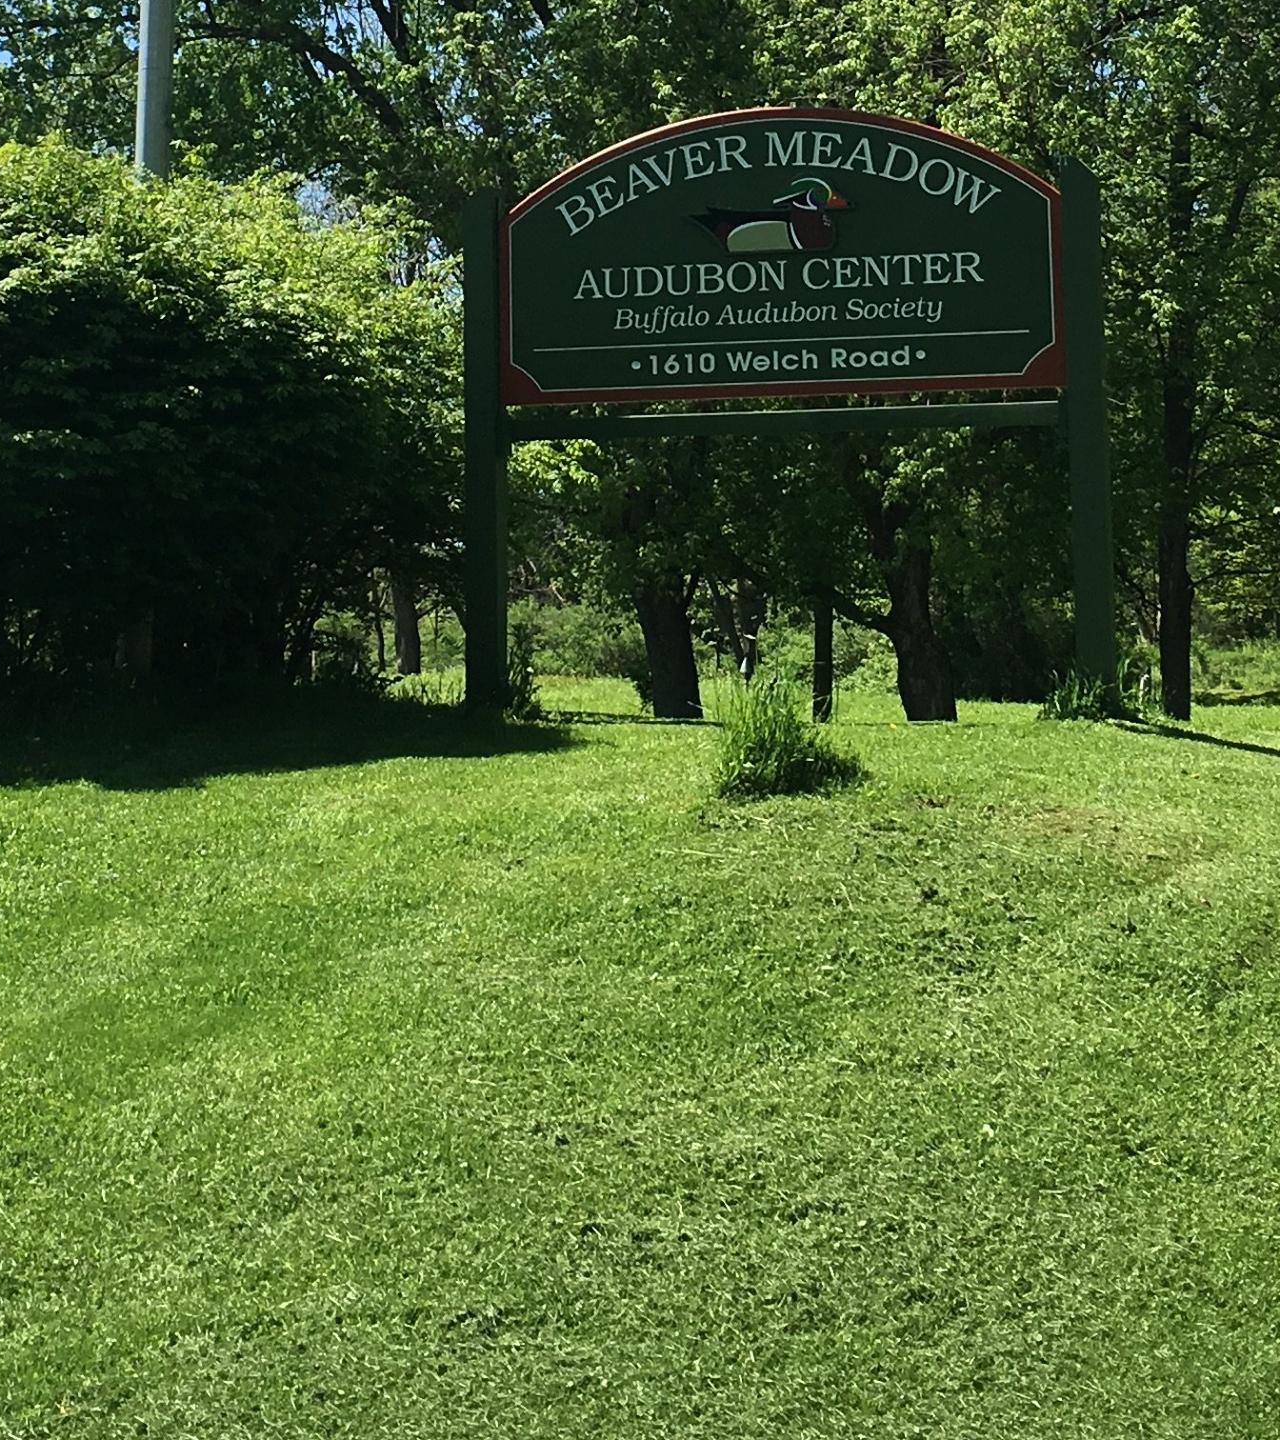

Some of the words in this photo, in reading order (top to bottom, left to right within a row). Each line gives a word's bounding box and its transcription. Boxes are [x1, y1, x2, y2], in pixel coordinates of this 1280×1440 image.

[554, 134, 753, 238] BEAVER
[763, 131, 1003, 216] MEADOW
[573, 260, 787, 300] AUDUBON
[802, 251, 985, 288] CENTER
[613, 305, 711, 334] Buffalo
[715, 301, 838, 326] Audubon
[845, 297, 943, 323] Society
[649, 353, 715, 375] 1610
[726, 349, 819, 372] Welch
[831, 345, 911, 369] Road
